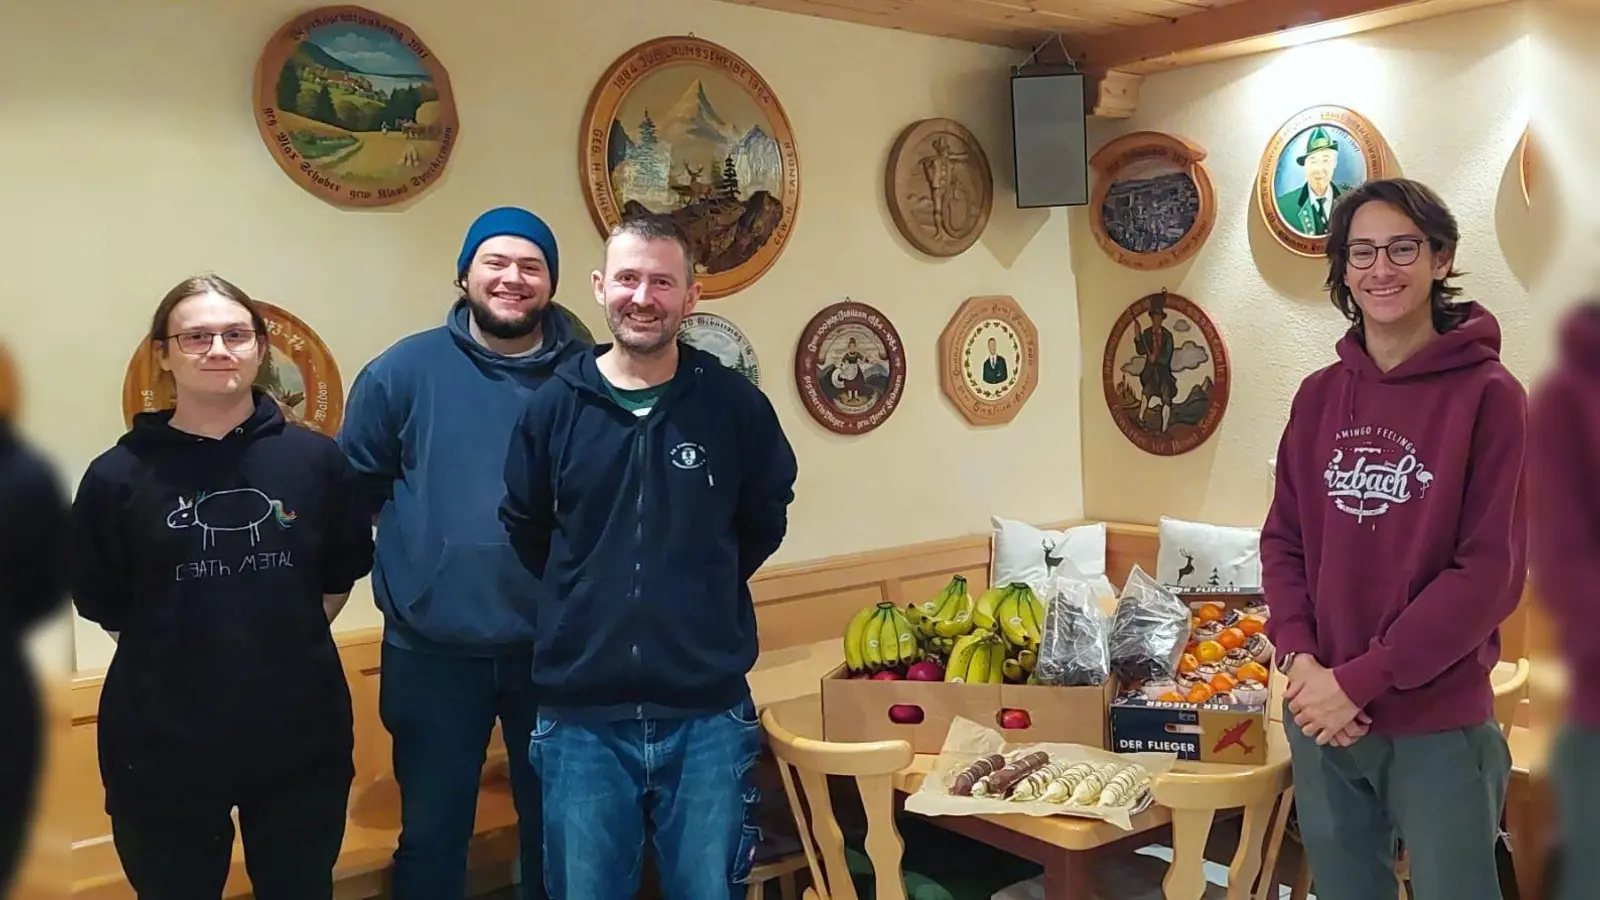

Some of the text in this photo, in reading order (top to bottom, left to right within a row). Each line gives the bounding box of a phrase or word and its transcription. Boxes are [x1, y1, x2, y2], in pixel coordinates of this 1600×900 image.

[612, 65, 639, 90] 1884
[593, 179, 617, 228] WINKLE
[1203, 703, 1229, 711] DER
[1119, 739, 1196, 753] DER FLIEGER
